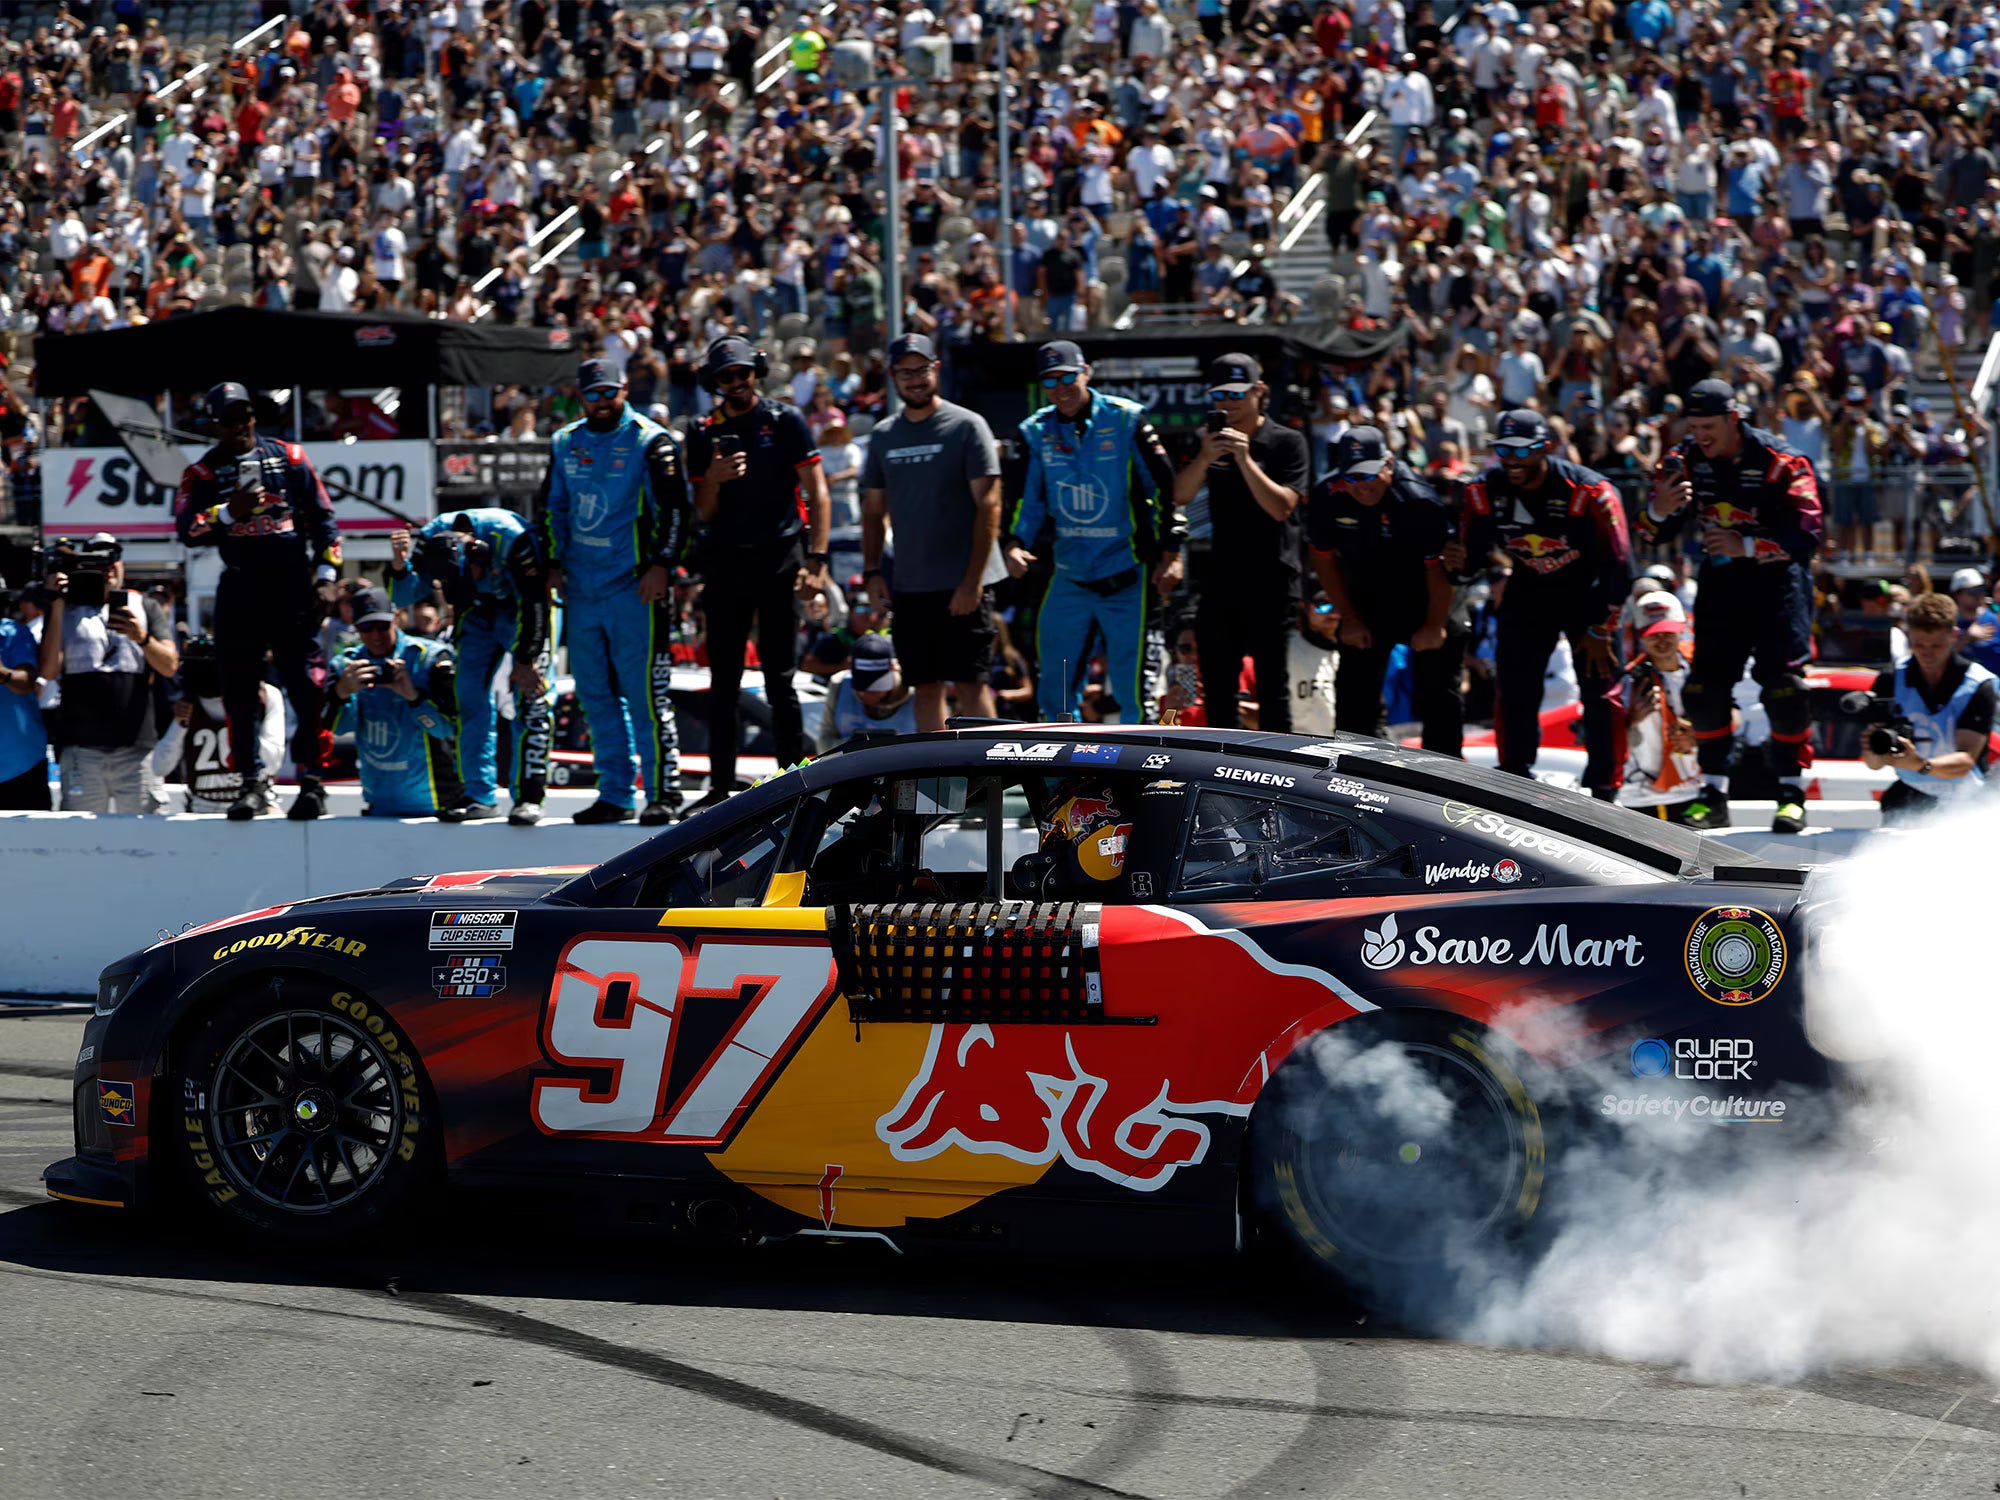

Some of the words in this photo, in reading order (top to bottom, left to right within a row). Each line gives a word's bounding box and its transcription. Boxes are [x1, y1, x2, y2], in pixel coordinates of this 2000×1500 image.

[1214, 766, 1296, 788] SIEMENS
[1329, 777, 1365, 790] FARO
[1326, 784, 1390, 804] CREAFORM
[1425, 859, 1490, 885] Wendy's
[457, 912, 505, 925] NASCAR
[213, 926, 367, 961] GOODYEAR
[440, 929, 463, 942] CUP
[464, 928, 502, 942] SERIES
[1409, 926, 1514, 965] Save
[1518, 923, 1645, 967] Mart
[1688, 921, 1709, 990] TRACKHOUSE
[1761, 920, 1782, 989] TRACKHOUSE
[450, 968, 488, 984] 250
[534, 934, 836, 1140] 97
[1675, 1038, 1754, 1059] QUAD
[331, 991, 421, 1162] GOODYEAR
[1675, 1060, 1752, 1080] LOCK
[100, 1096, 132, 1112] SUNOCO
[1601, 1094, 1786, 1119] SafetyCulture
[184, 1116, 239, 1203] EAGLE
